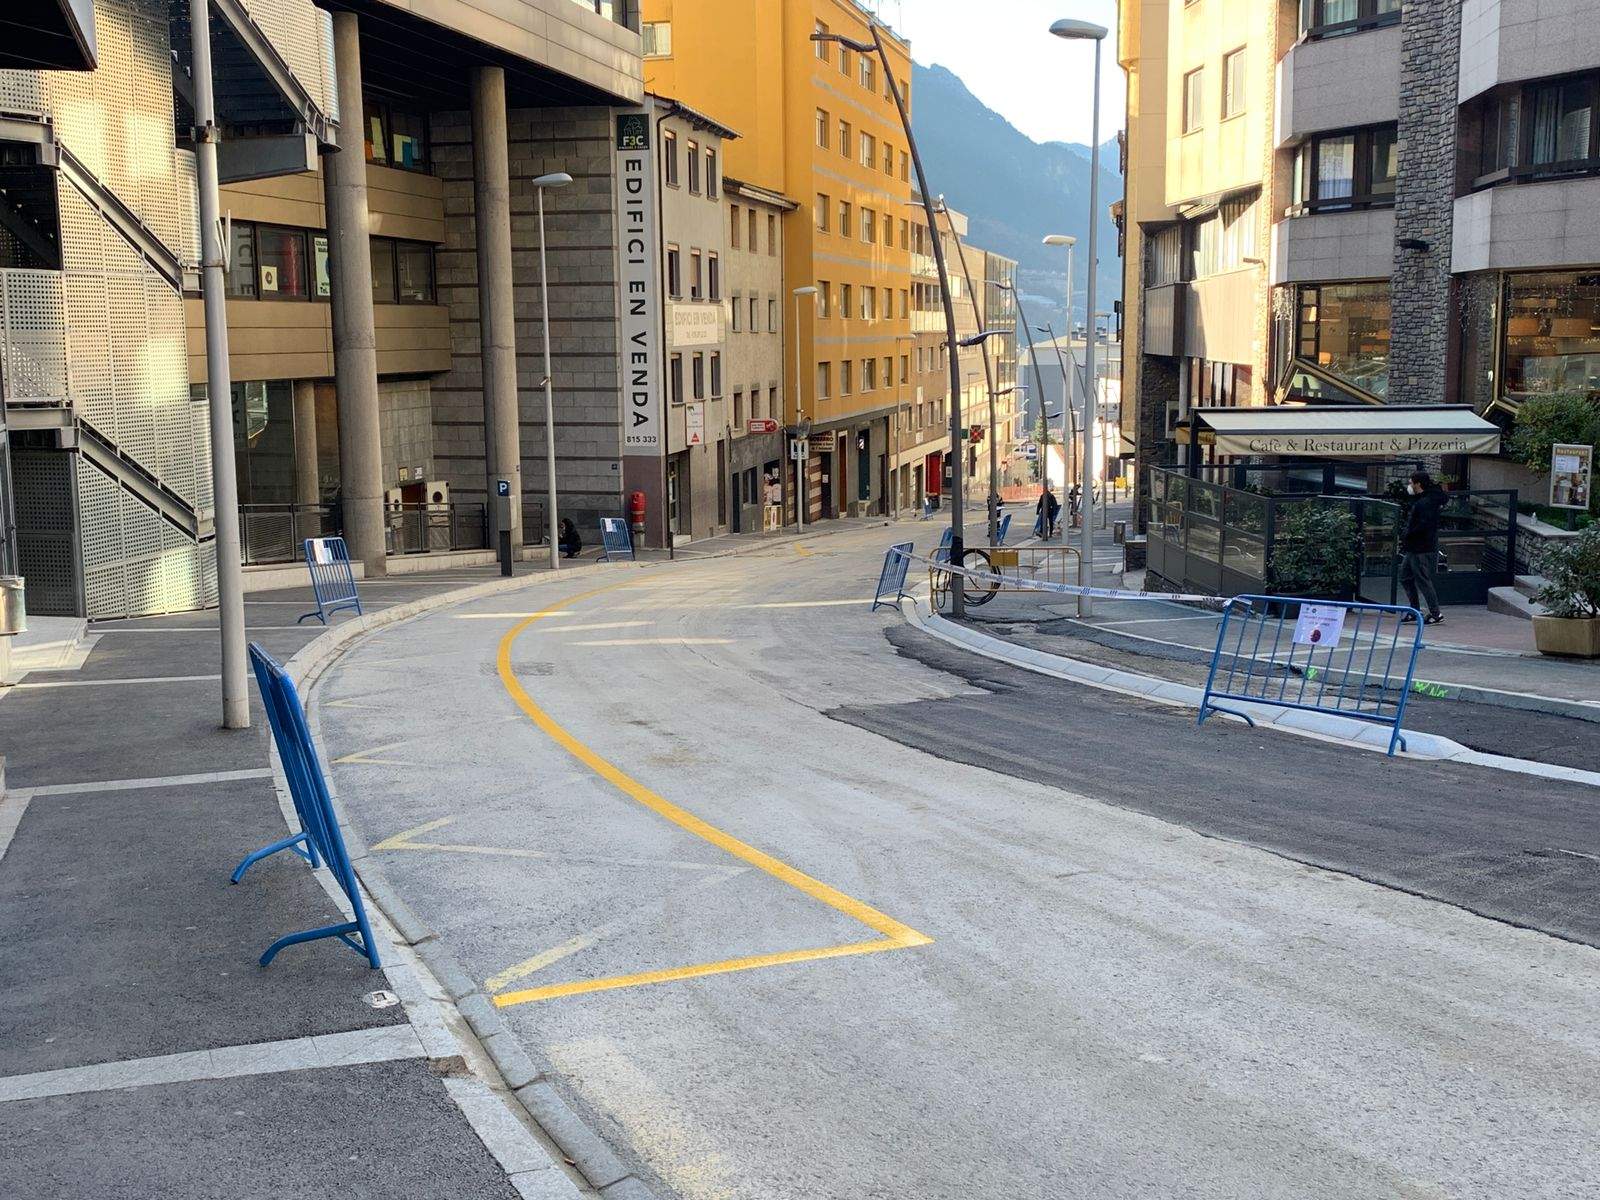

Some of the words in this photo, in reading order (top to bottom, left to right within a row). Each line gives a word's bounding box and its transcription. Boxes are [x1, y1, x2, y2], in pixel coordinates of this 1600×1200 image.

[622, 135, 644, 146] F3C
[625, 159, 645, 264] EDIFICI
[629, 281, 646, 315] EN
[631, 331, 649, 427] VENDA
[1286, 438, 1299, 451] &
[1304, 438, 1384, 452] Restaurant
[1389, 438, 1402, 451] &
[1408, 437, 1468, 451] Pizzeria
[499, 482, 508, 493] P
